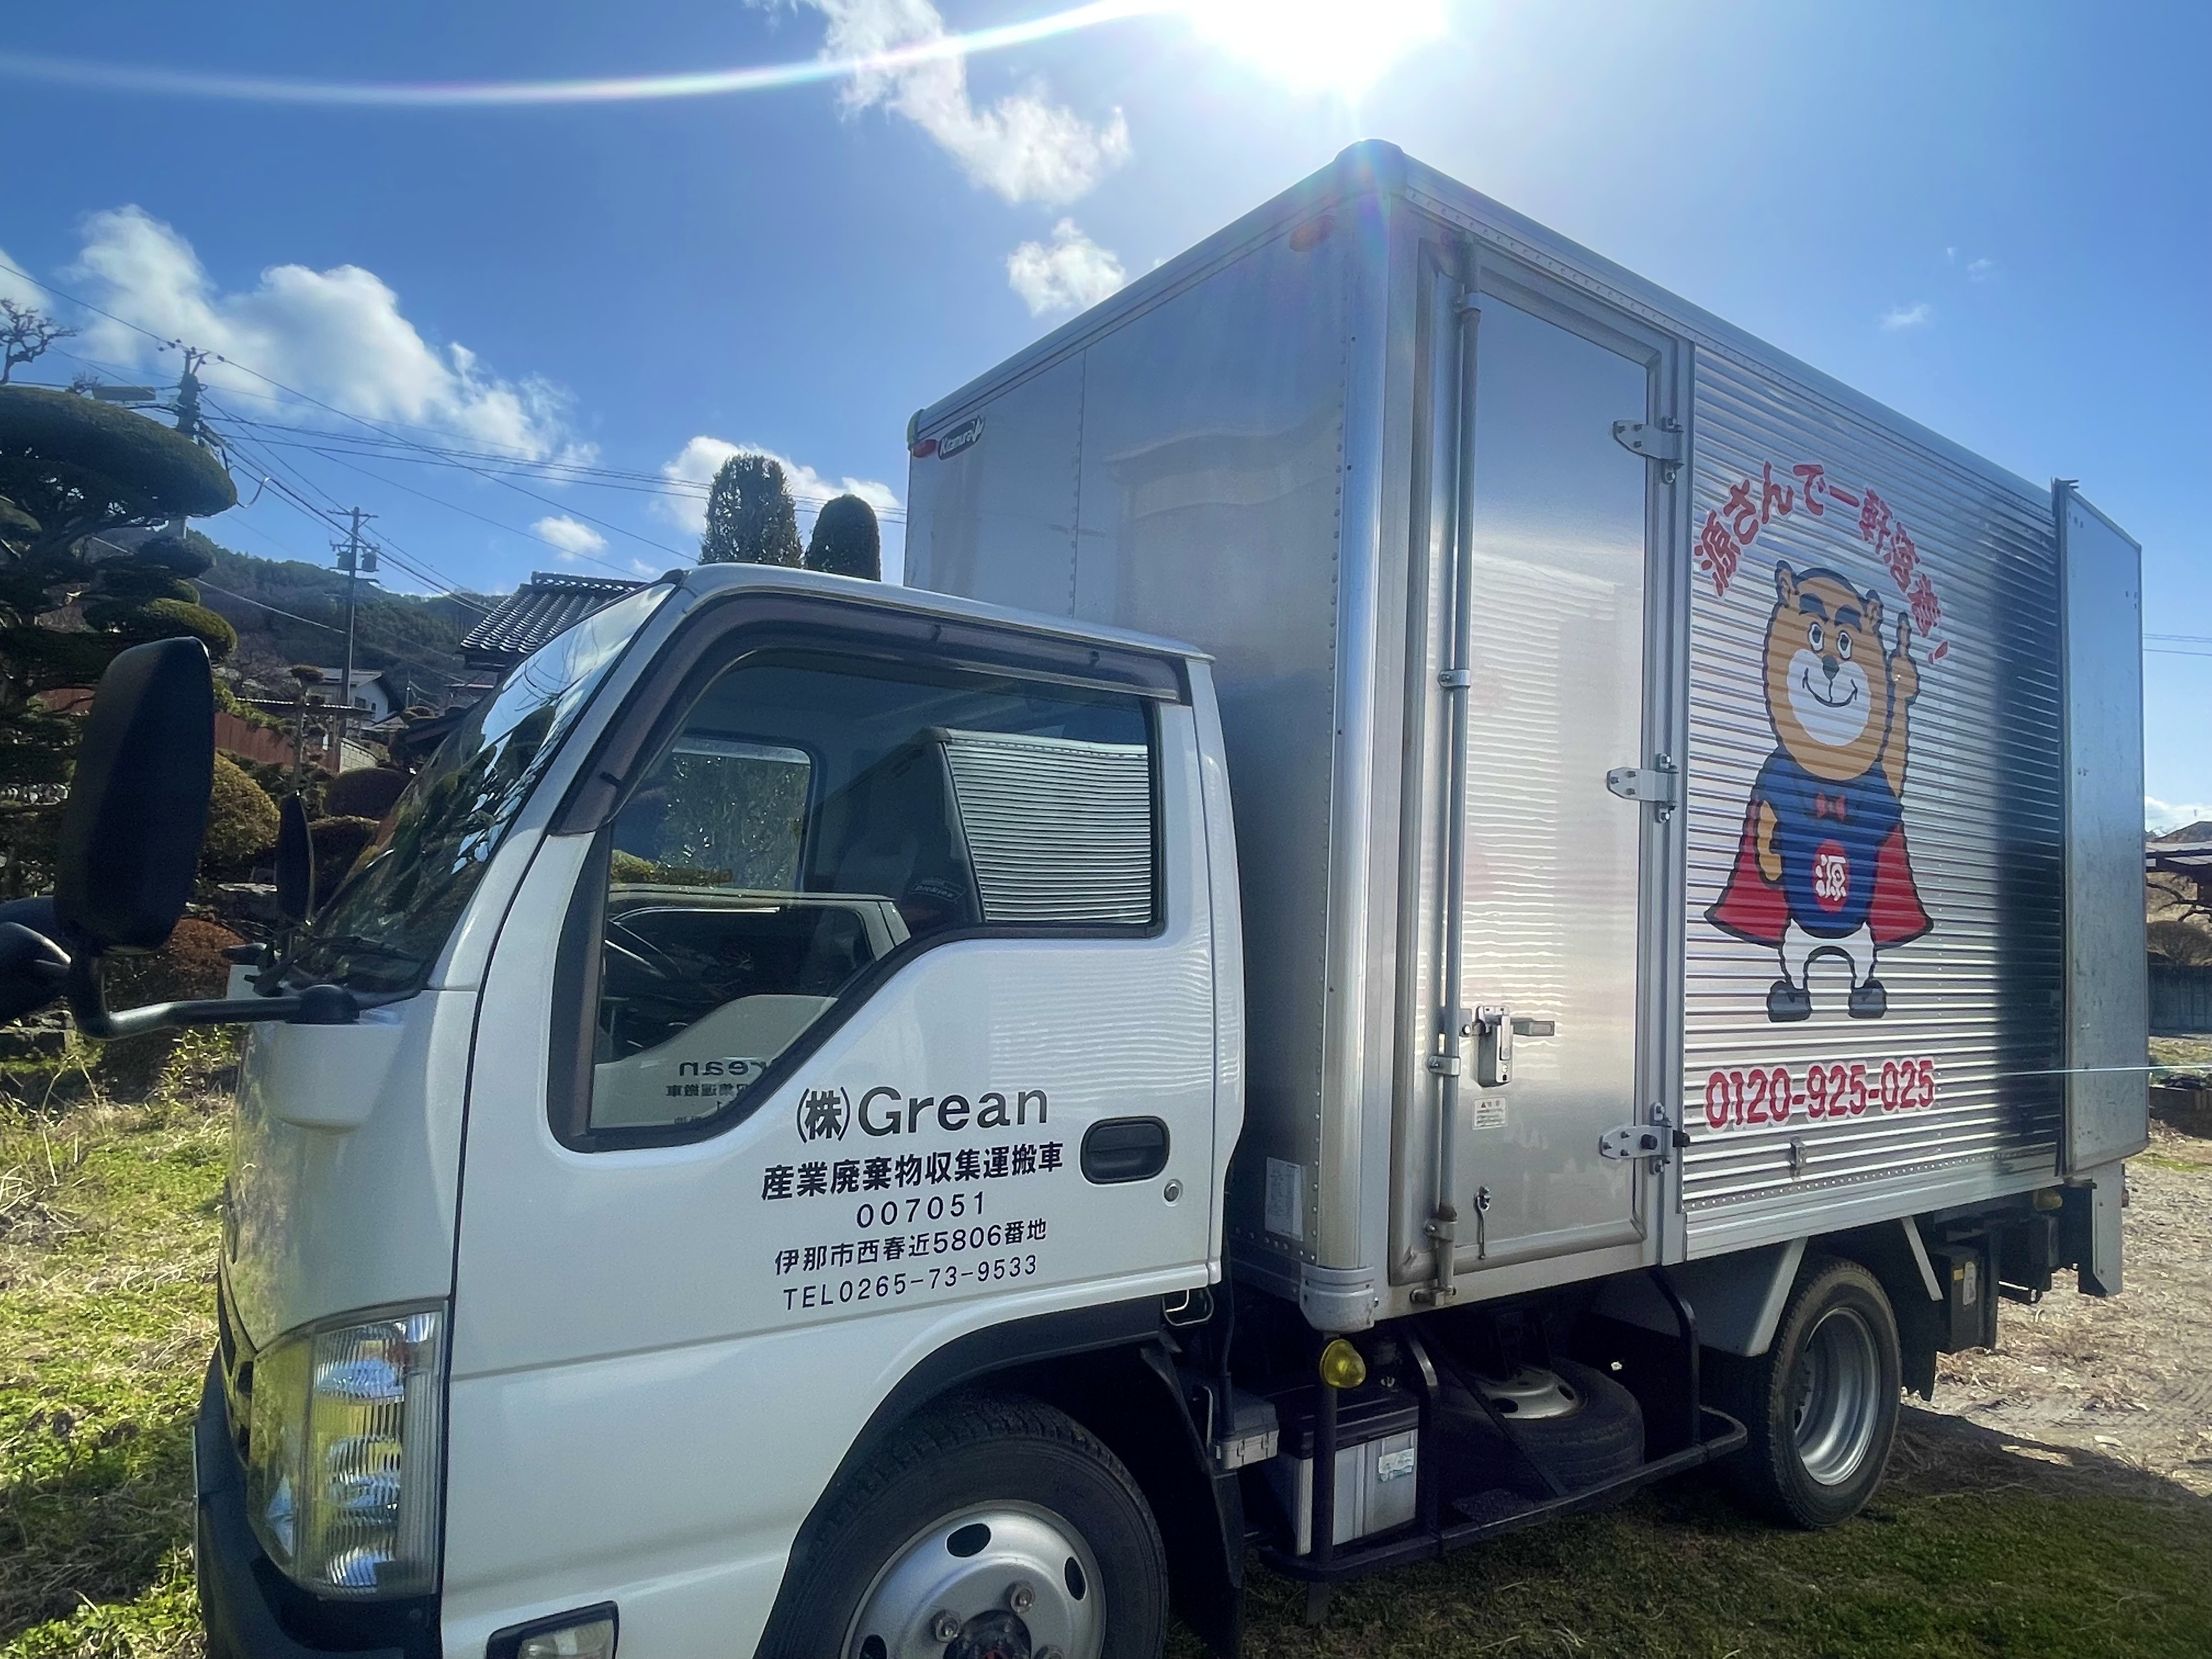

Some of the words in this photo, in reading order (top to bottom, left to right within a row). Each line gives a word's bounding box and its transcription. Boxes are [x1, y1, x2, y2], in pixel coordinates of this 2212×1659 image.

[1706, 1059, 1934, 1128] 0120-925-025
[761, 1141, 1064, 1201] 産業廃棄物収集運搬車
[856, 1191, 985, 1228] 007051
[775, 1218, 1047, 1277] 伊那市西春近5806番地
[783, 1254, 1037, 1311] TEL0265-73-9533
